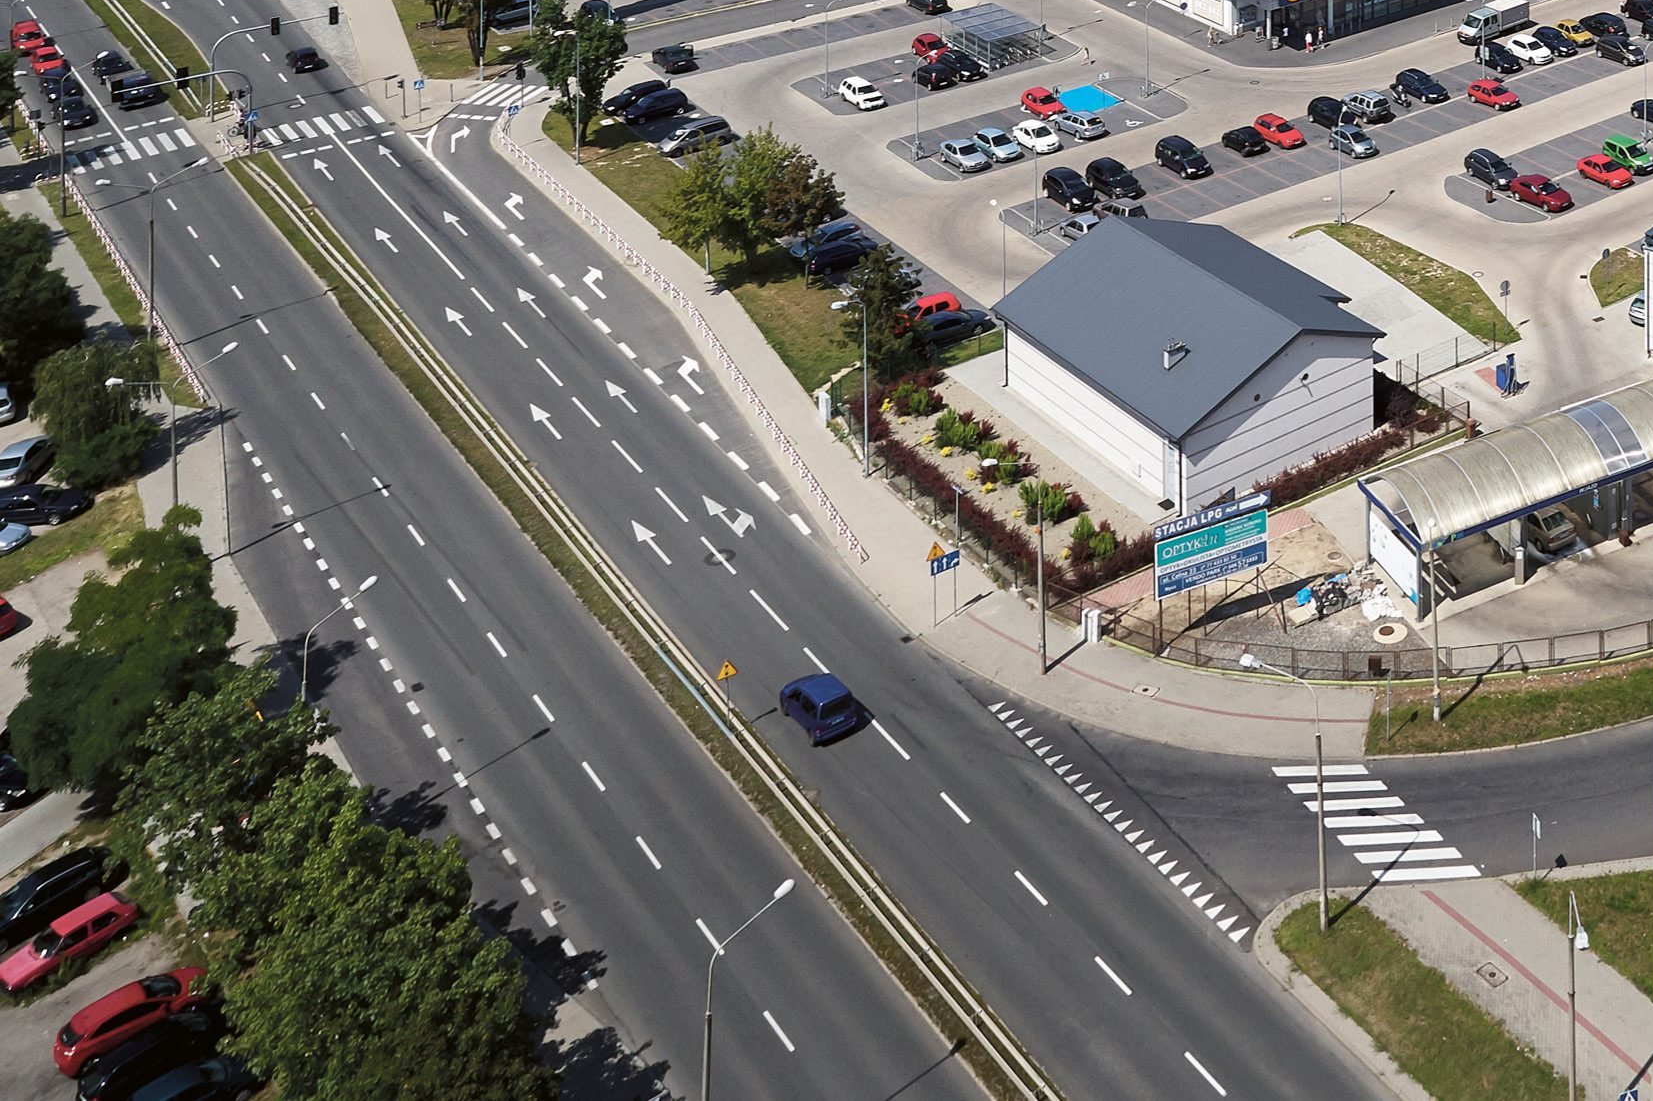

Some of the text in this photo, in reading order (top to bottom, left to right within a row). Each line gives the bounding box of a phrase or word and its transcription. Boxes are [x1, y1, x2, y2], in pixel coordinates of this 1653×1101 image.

[1155, 518, 1198, 539] STACJA
[1201, 508, 1223, 527] LPG
[1185, 572, 1206, 584] VENDO
[1206, 567, 1221, 578] PARK
